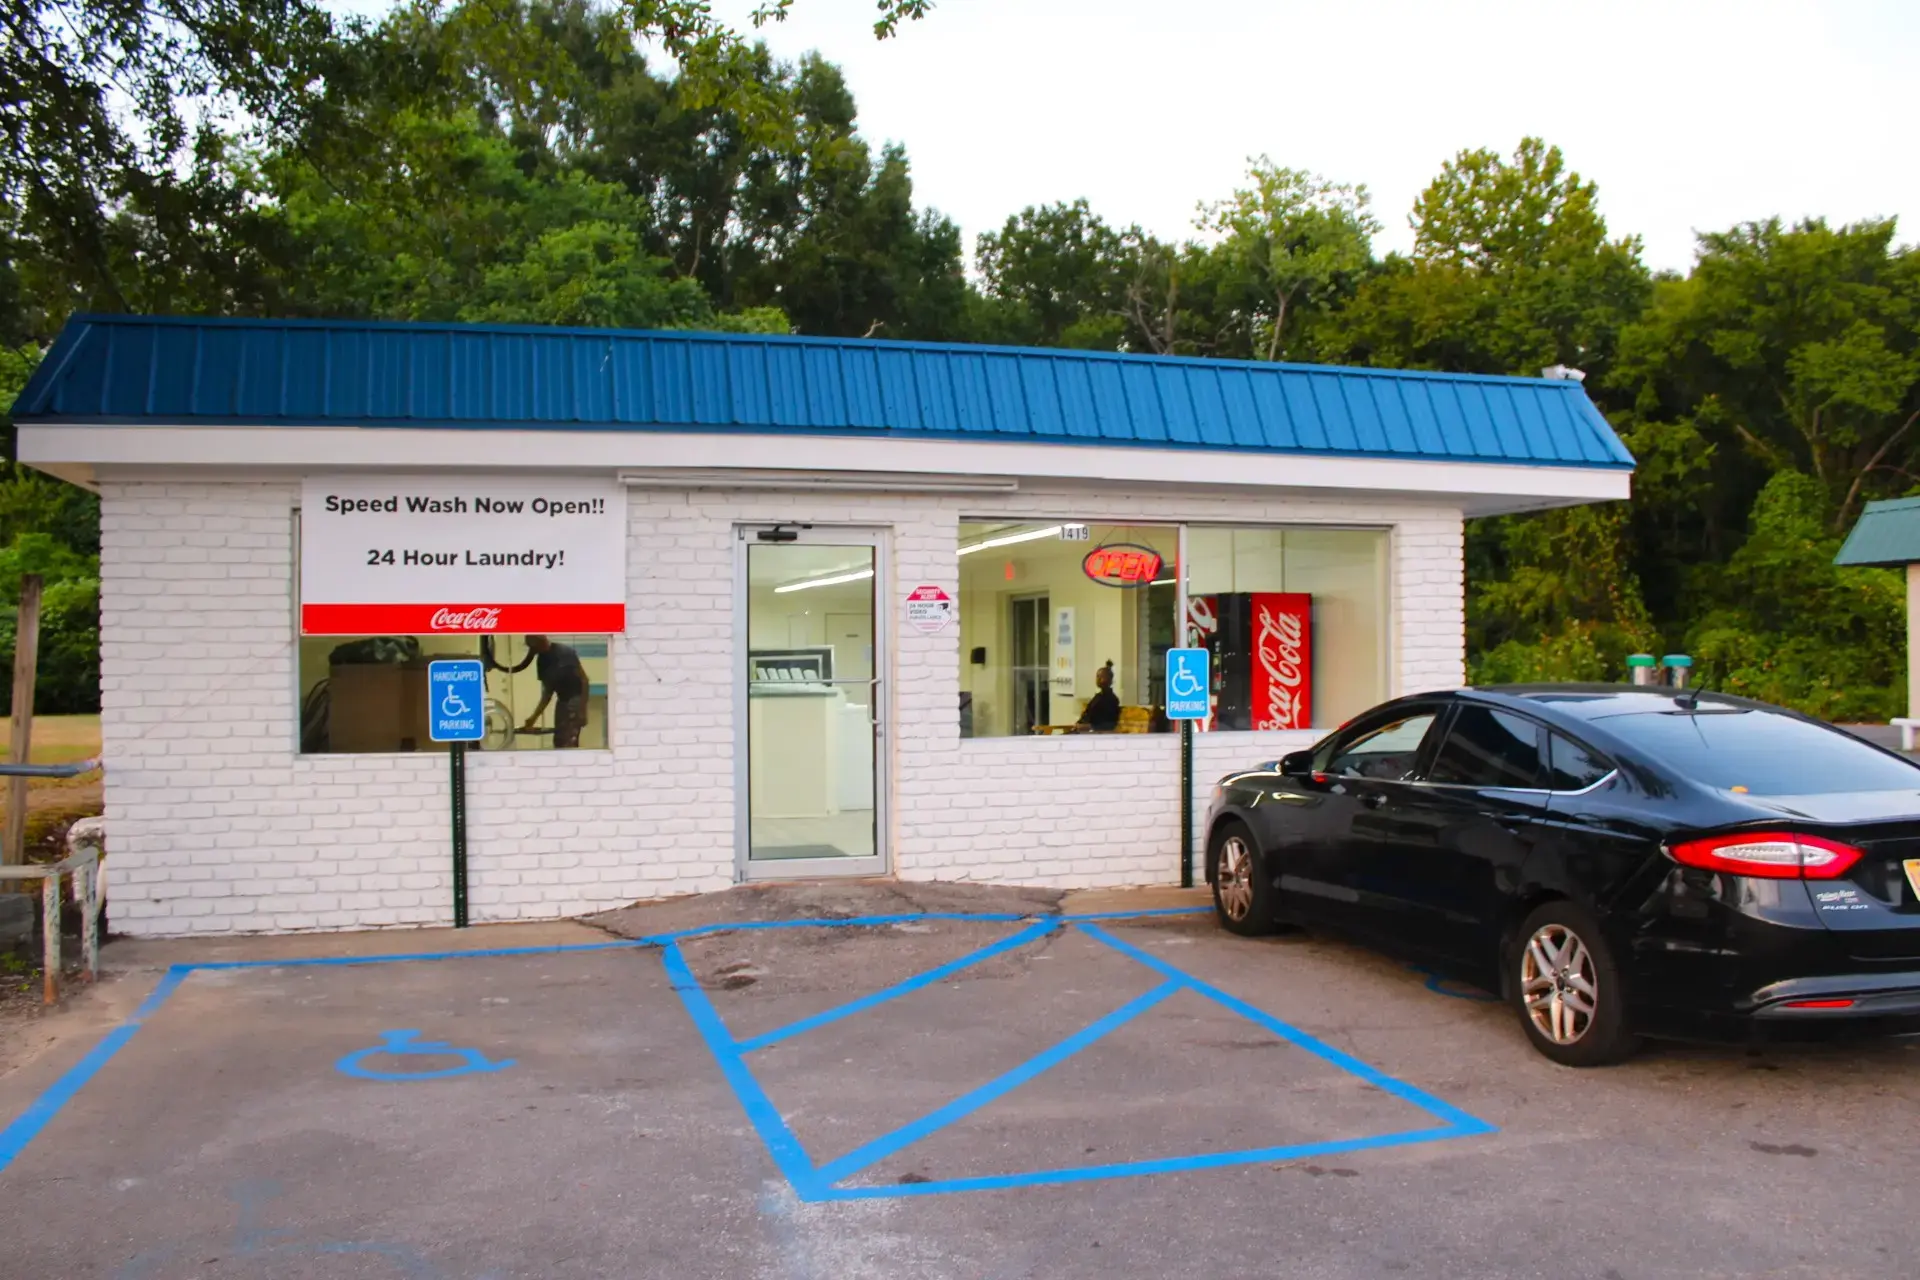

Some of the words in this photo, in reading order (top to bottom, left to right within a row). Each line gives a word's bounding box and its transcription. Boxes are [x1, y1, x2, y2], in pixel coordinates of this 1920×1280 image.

[325, 495, 398, 515] Speed
[405, 496, 467, 513] Wash
[475, 497, 524, 514] Now
[531, 498, 605, 516] Open!!
[1061, 526, 1088, 540] 1419
[367, 549, 395, 566] 24
[403, 549, 458, 566] Hour
[465, 549, 564, 569] Laundry!
[1086, 550, 1160, 582] OPEN
[430, 607, 502, 630] Coca-Cola
[432, 670, 479, 682] HANDICAPPED
[1169, 700, 1206, 713] PARKING
[439, 719, 475, 730] PARKING
